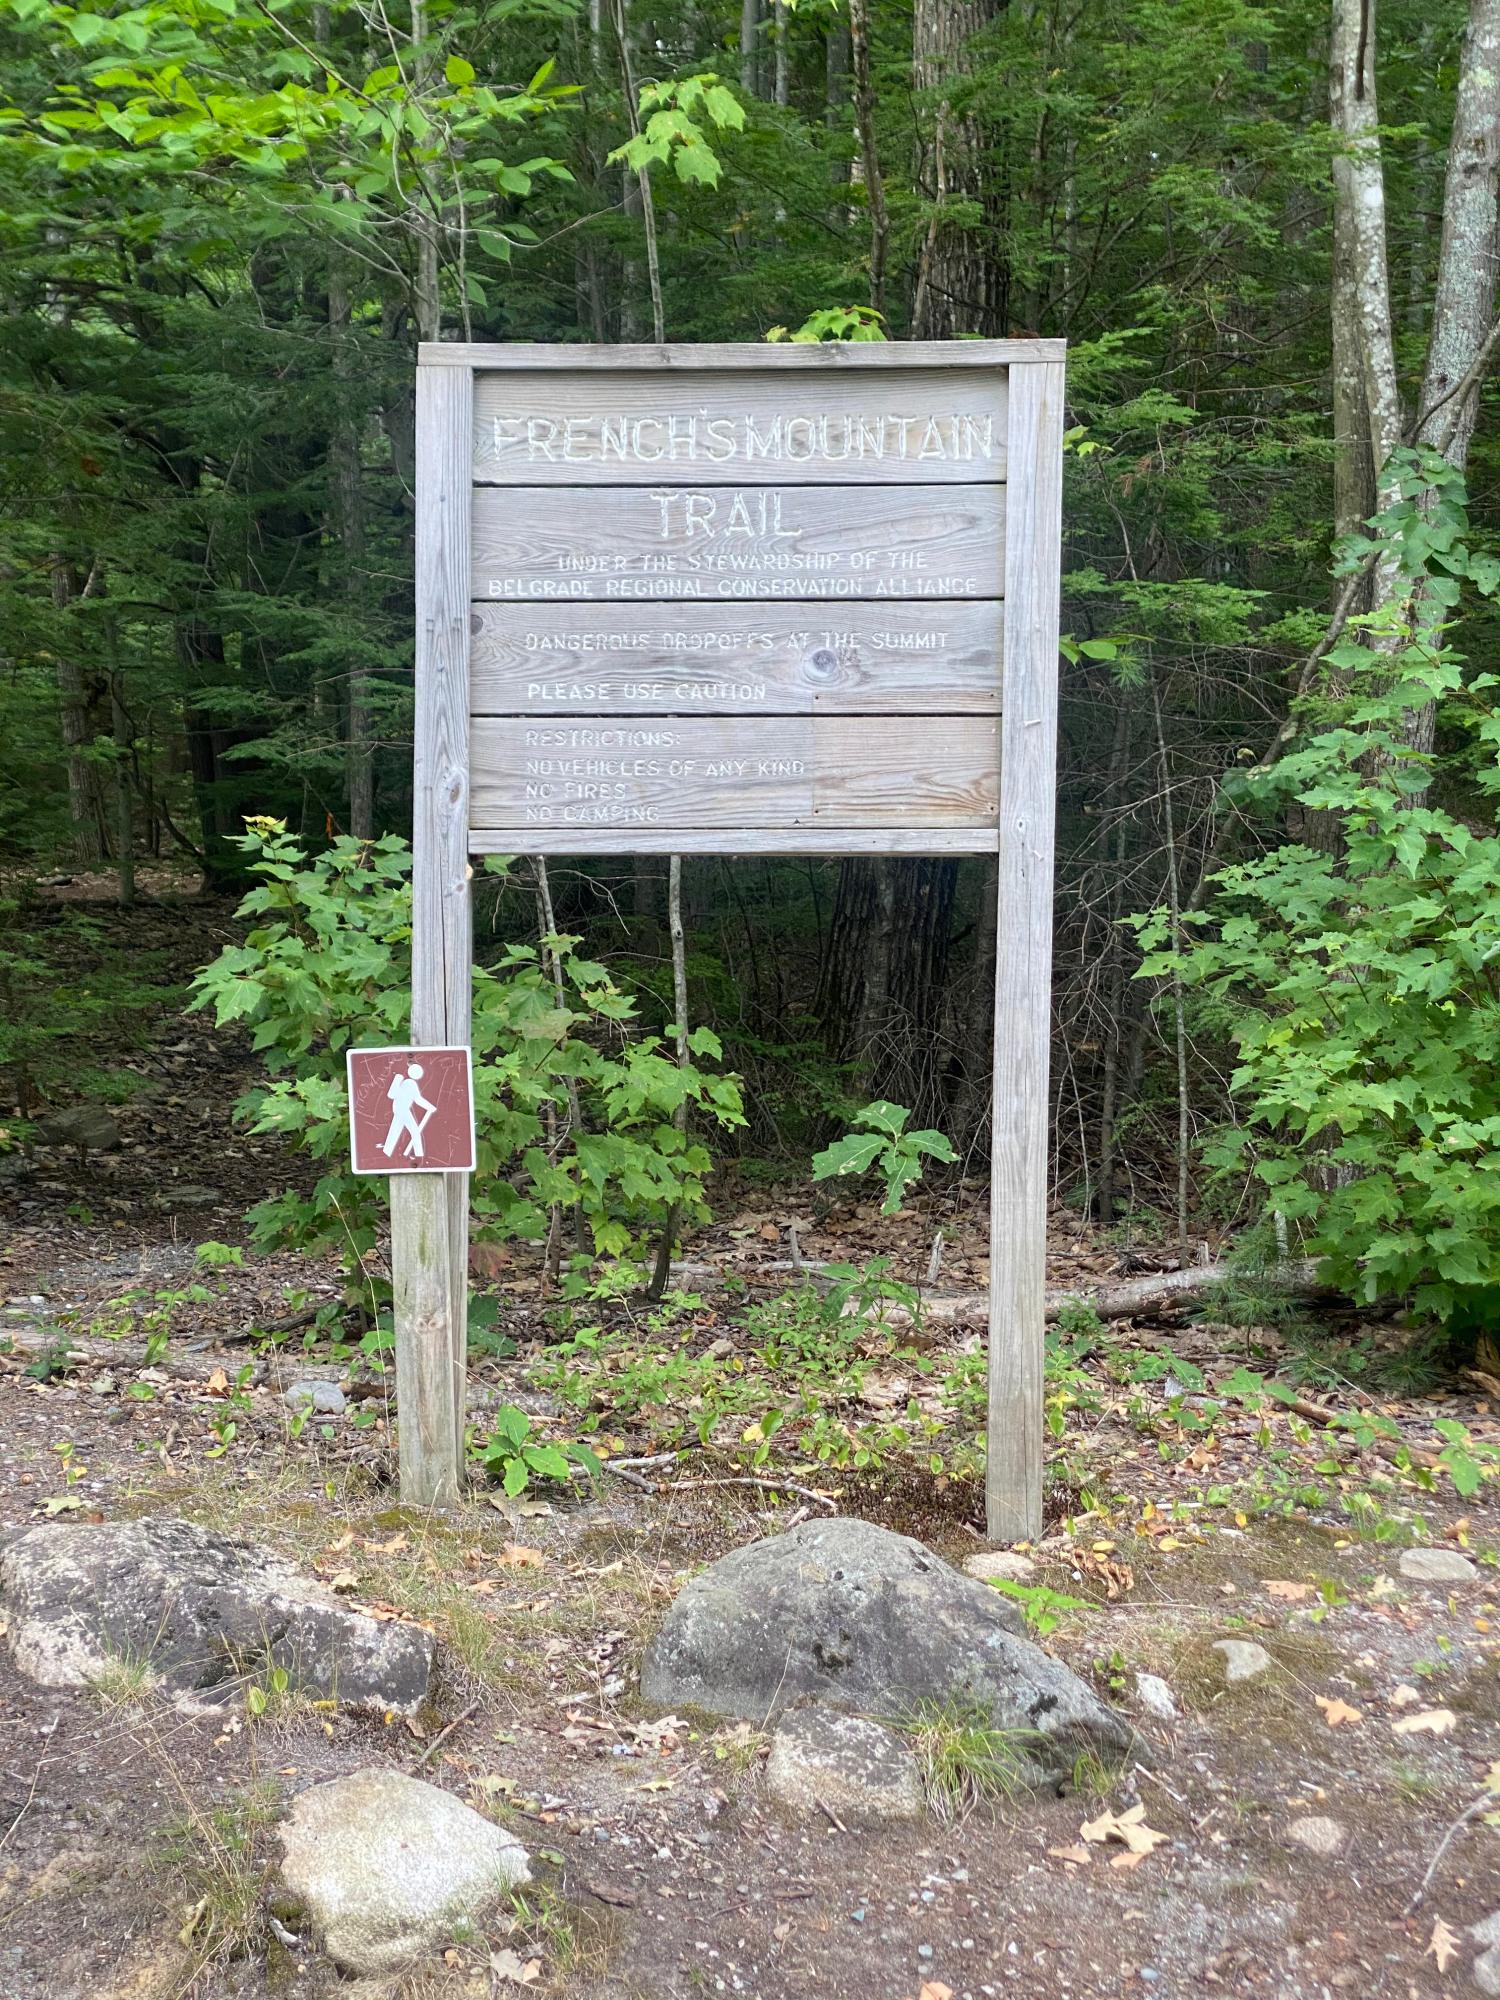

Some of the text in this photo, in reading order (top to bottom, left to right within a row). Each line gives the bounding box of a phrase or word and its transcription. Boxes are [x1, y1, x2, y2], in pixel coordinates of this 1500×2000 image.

[493, 408, 993, 462] FRENCH'S MOUNTAIN
[650, 491, 802, 538] TRAIL
[558, 552, 928, 571] UNDER THE STEWARDSHIP OF THE
[488, 577, 977, 597] BELGRADE REGIONAL CONSERVATION ALLIANCE
[526, 632, 949, 651] DANGEROUS DROPOFFS AT THE SUMMIT
[528, 682, 766, 700] PLEASE USE CAUTION
[526, 729, 682, 747] RESTRICTIONS:
[527, 759, 805, 777] NO VEHICLES OF ANY KIND
[526, 782, 627, 799] NO FIRES
[526, 805, 661, 822] NO CAMPING
